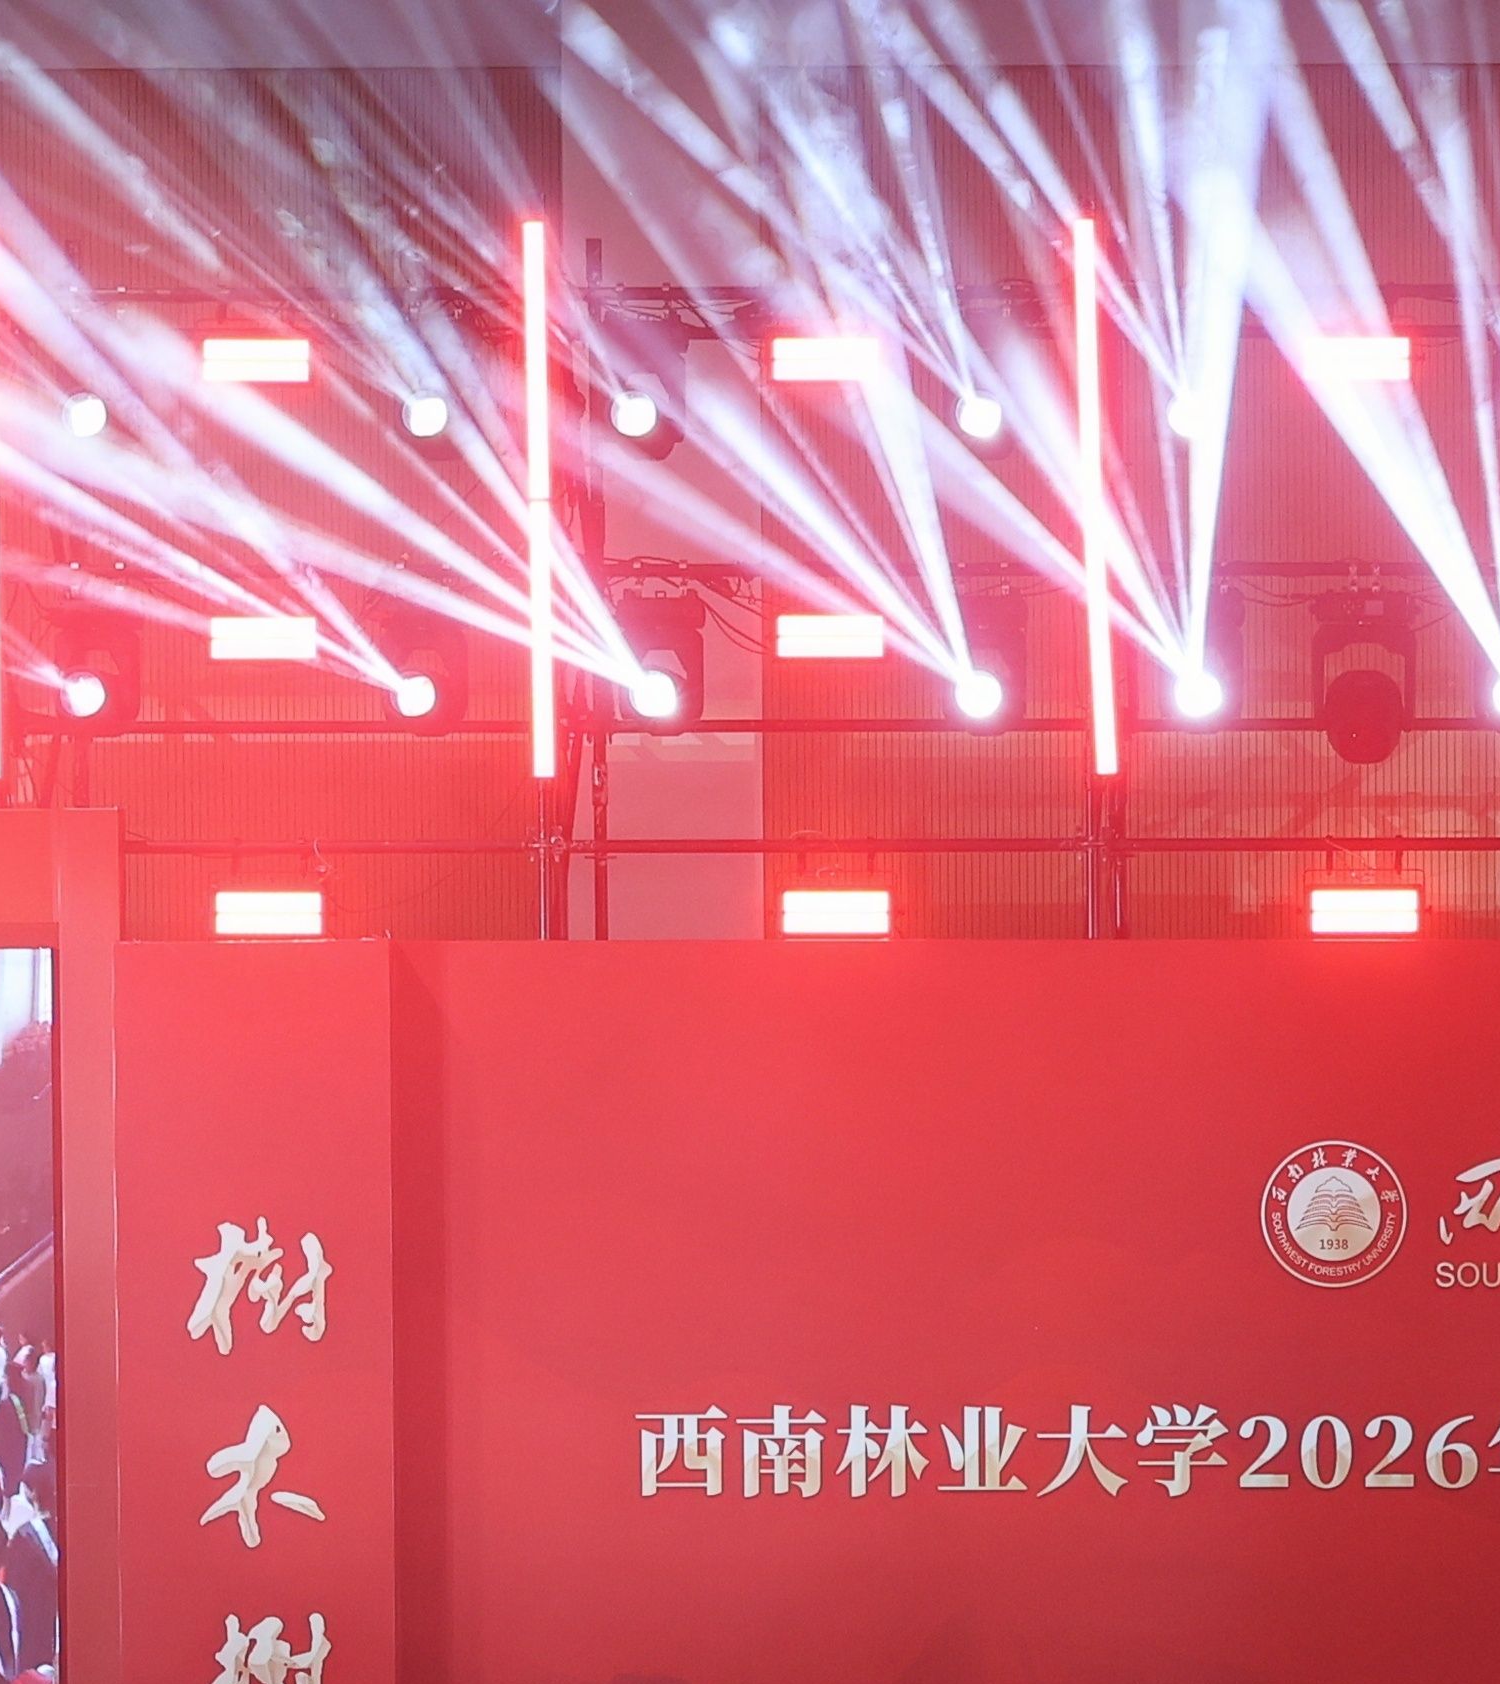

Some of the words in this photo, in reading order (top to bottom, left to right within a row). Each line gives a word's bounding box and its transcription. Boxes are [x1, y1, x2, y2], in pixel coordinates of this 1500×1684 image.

[1271, 1212, 1309, 1268] SOUTHWEST
[1307, 1262, 1362, 1277] FORESTRY
[1362, 1212, 1397, 1267] UNIVERSITY
[1319, 1239, 1349, 1250] 1938
